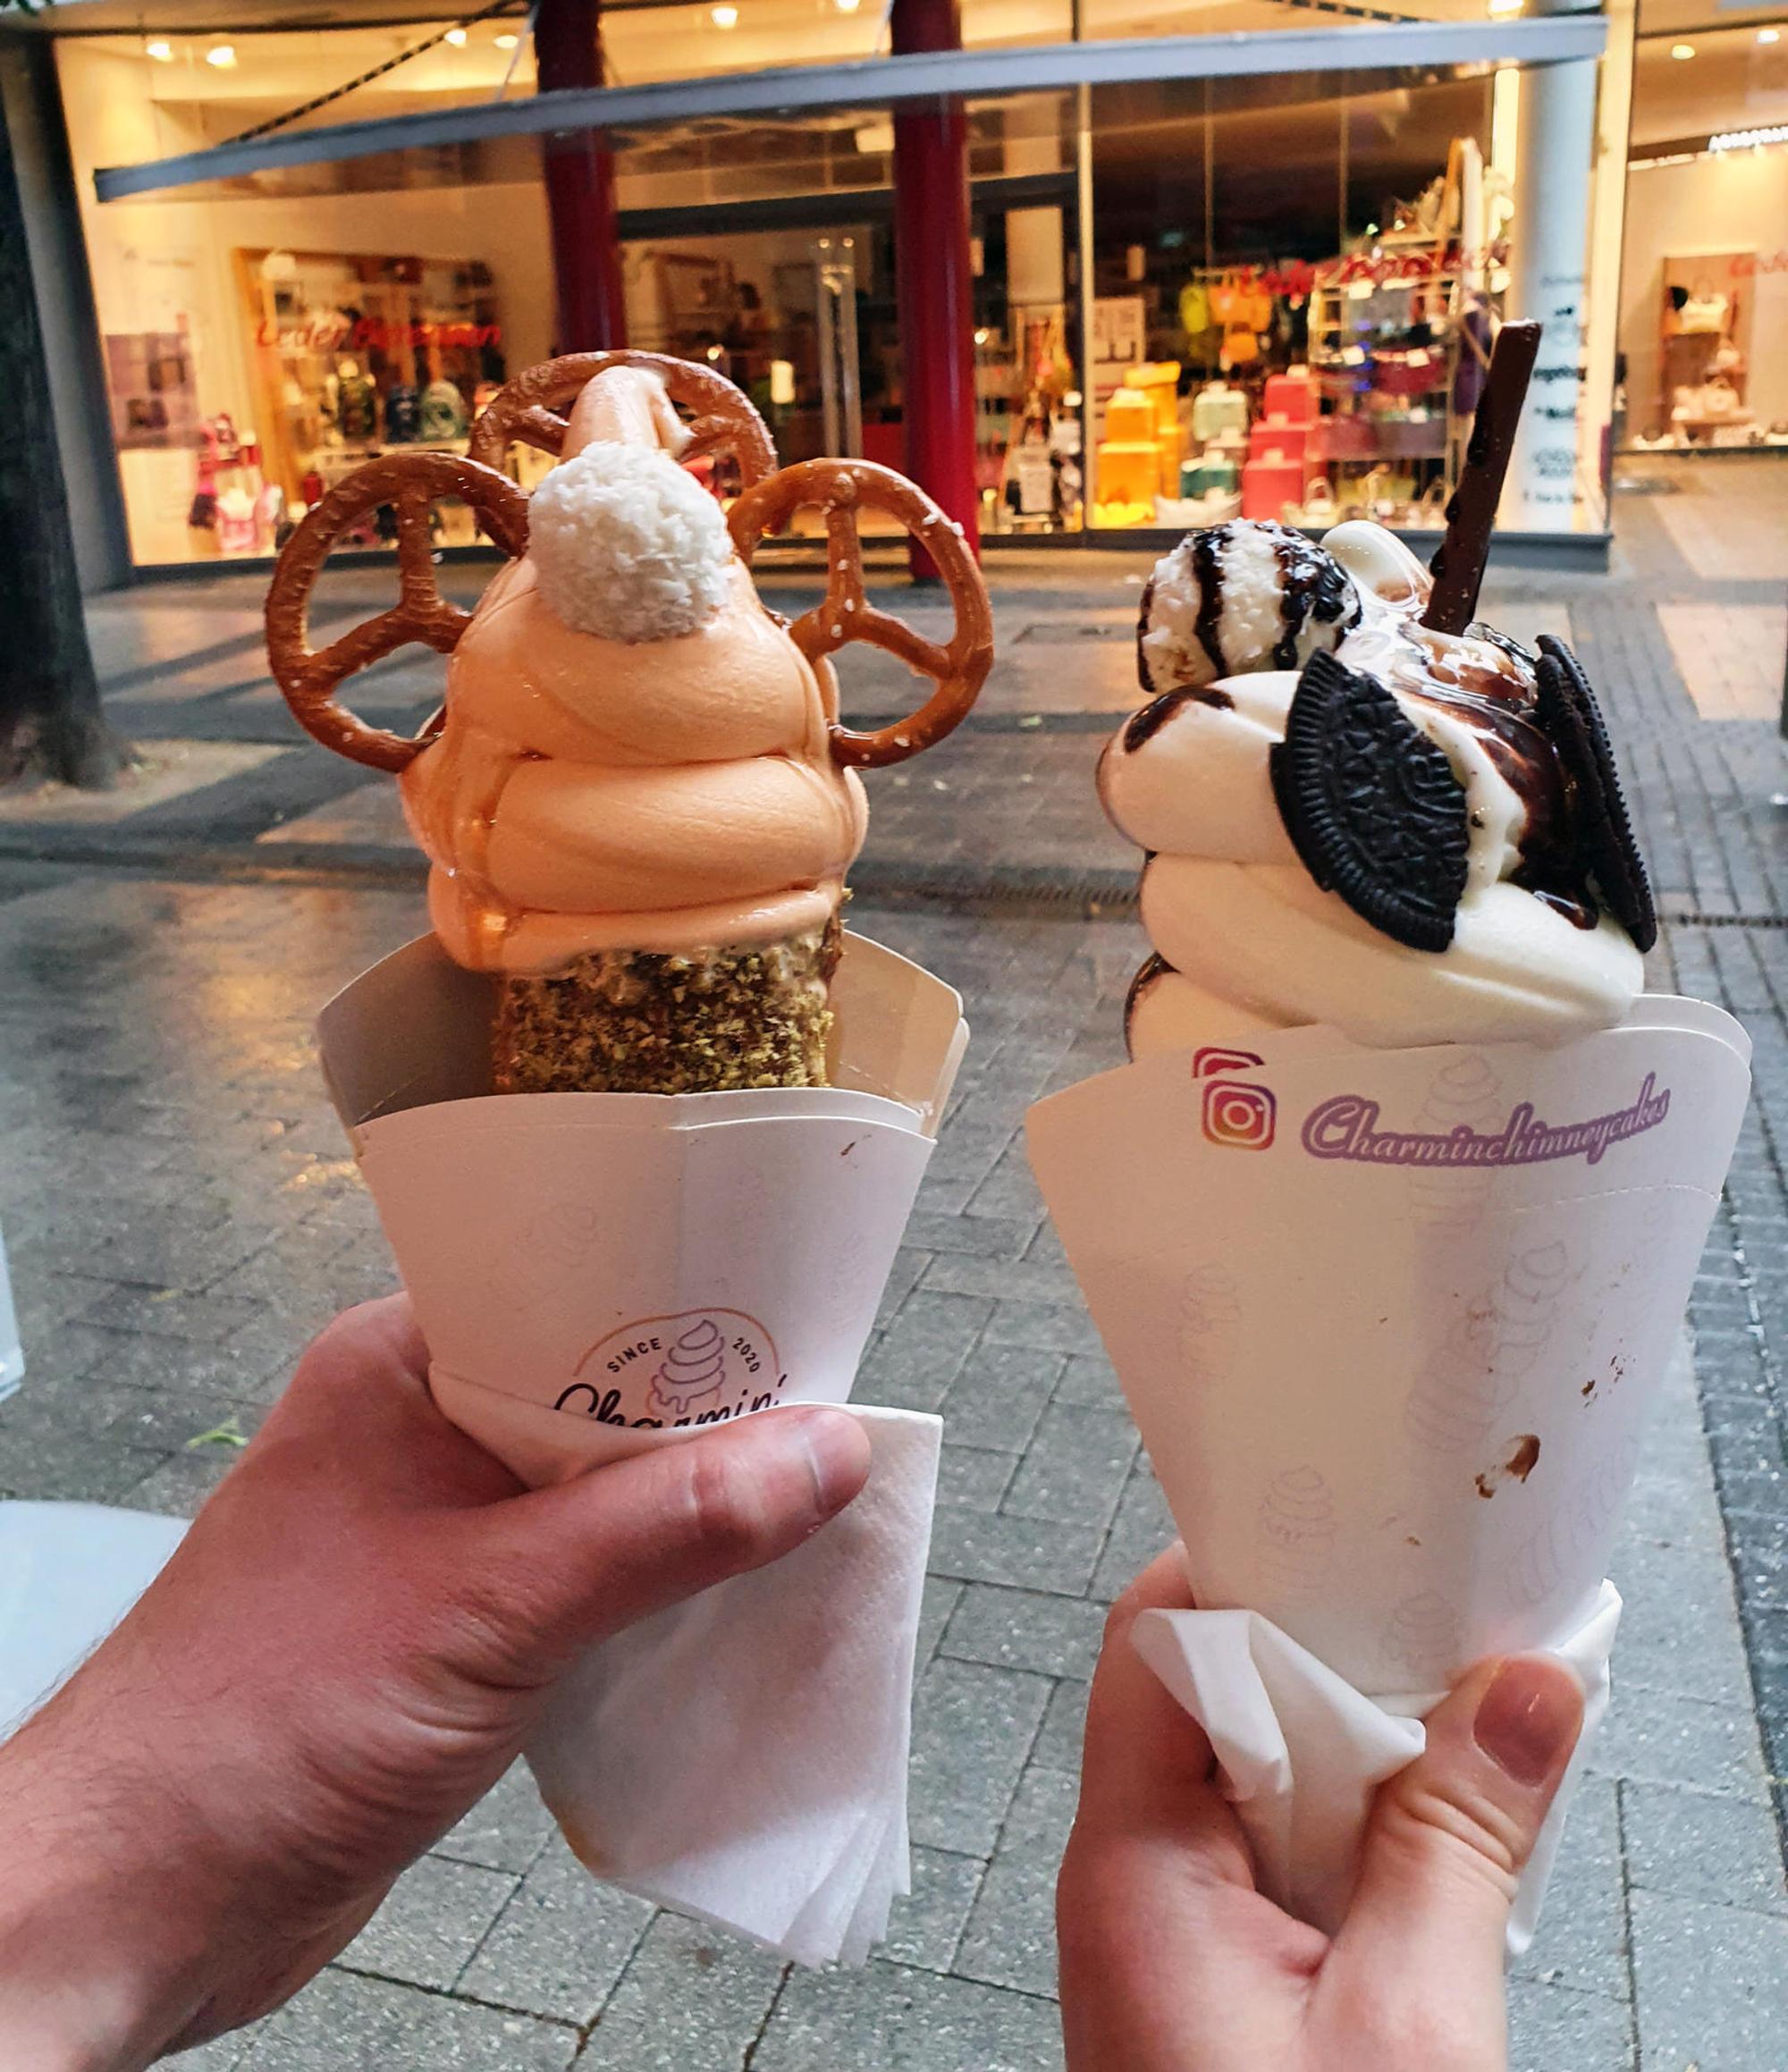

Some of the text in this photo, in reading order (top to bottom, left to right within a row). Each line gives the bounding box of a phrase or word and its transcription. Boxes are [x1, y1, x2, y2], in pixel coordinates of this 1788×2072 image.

[1303, 1073, 1670, 1165] Charminchimneycakes
[607, 1337, 662, 1373] SINCE
[732, 1337, 761, 1373] 2020
